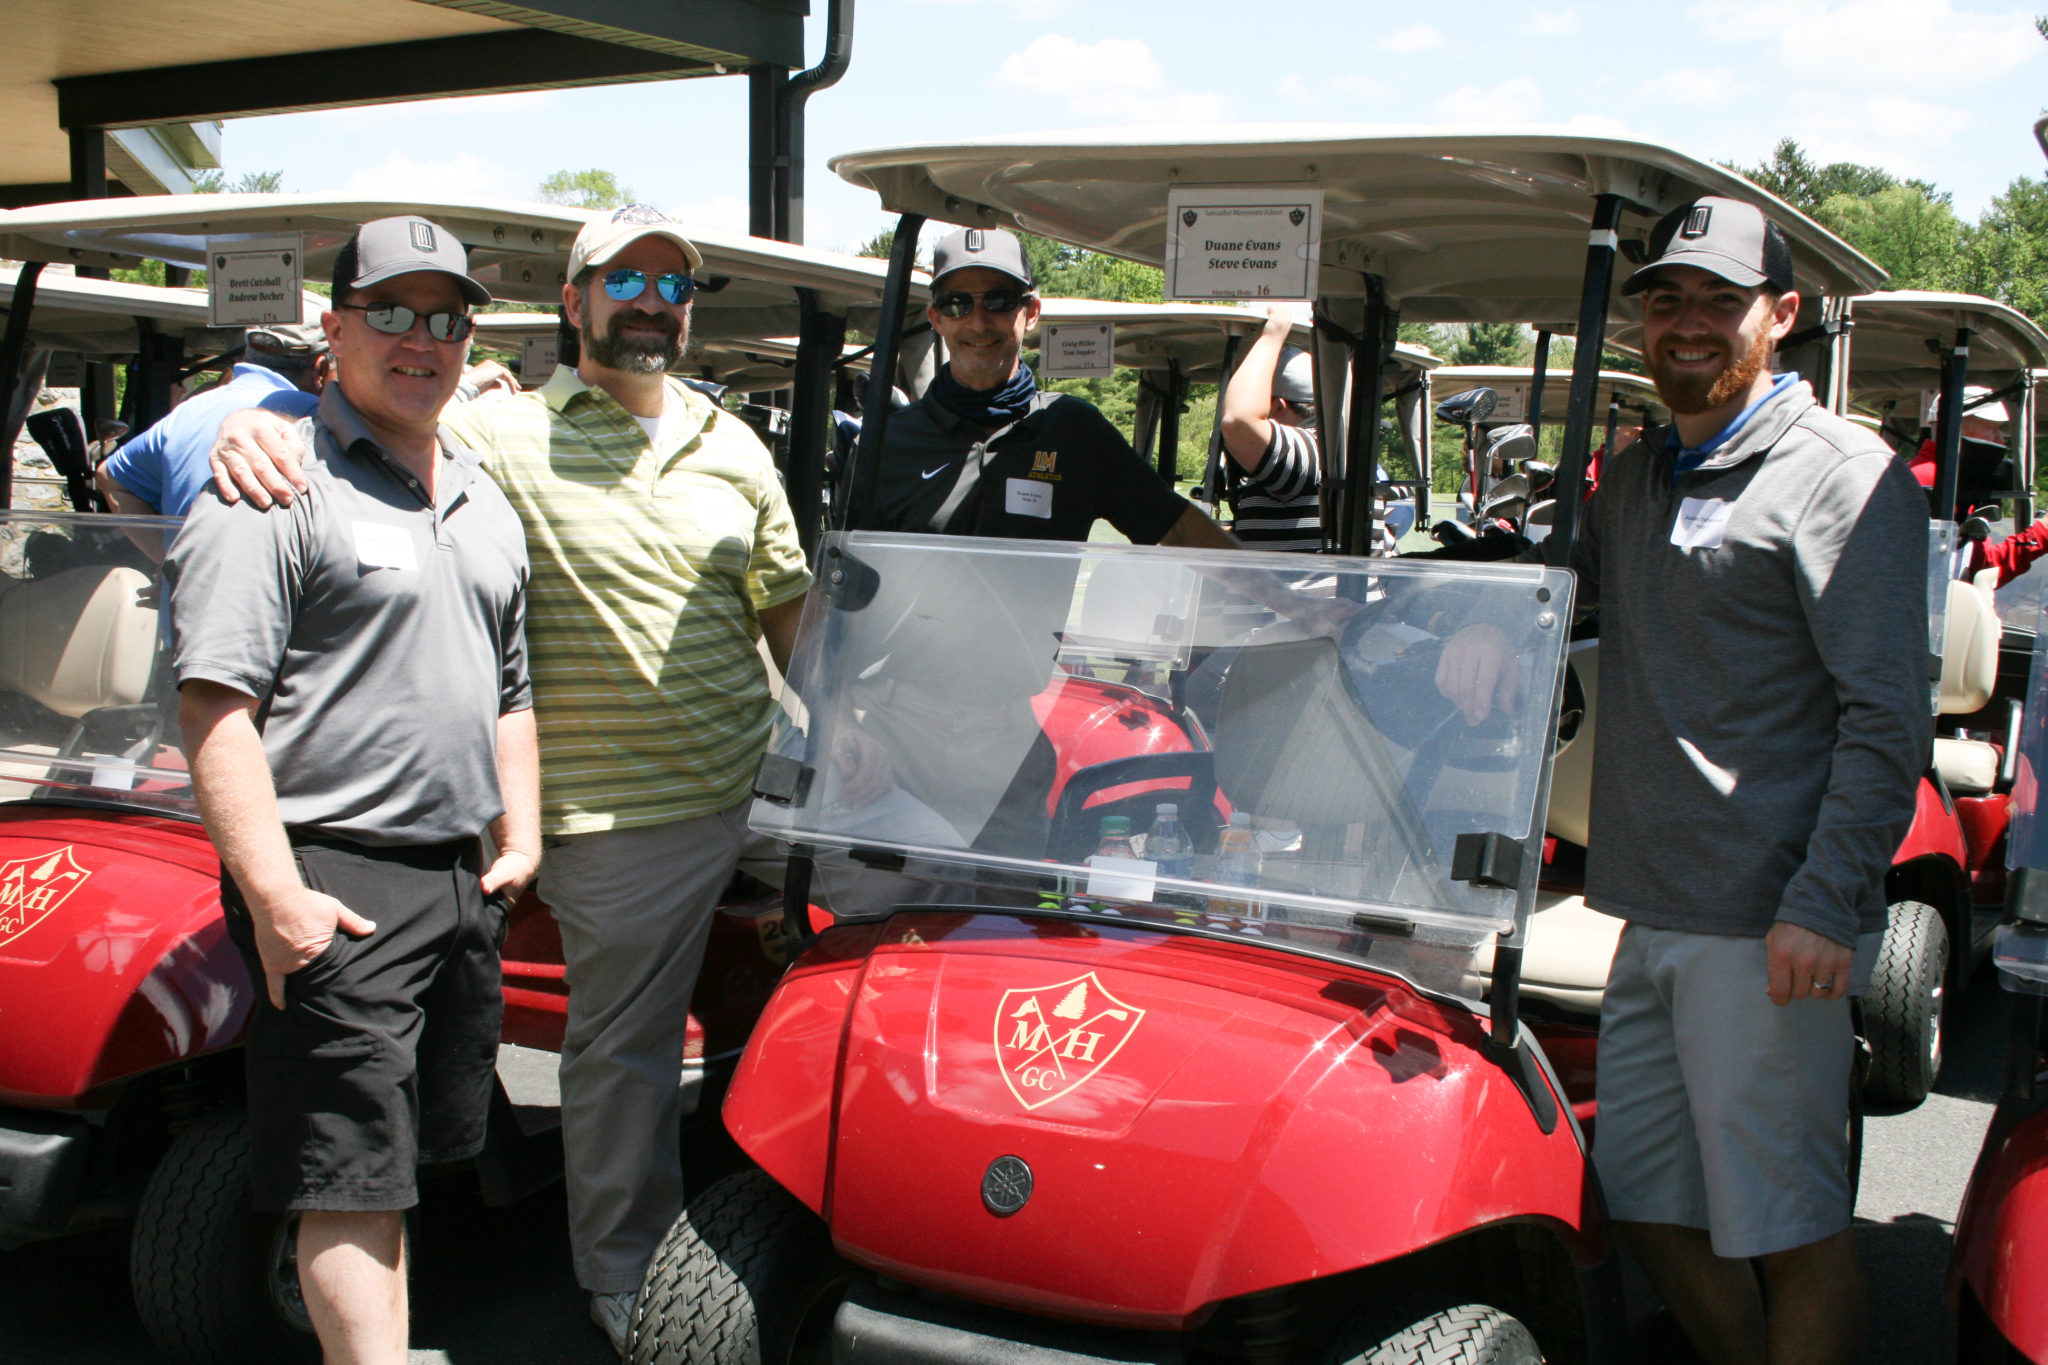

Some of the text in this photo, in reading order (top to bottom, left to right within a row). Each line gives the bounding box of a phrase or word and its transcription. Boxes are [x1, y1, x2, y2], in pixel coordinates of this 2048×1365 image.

[1205, 239, 1281, 251] Duane Evans
[1208, 258, 1278, 269] Steve Evans
[229, 276, 281, 288] Brett Cutshall
[1257, 284, 1270, 296] 16
[228, 292, 258, 302] Andrew
[1032, 450, 1058, 473] LM
[1021, 1066, 1057, 1091] GC
